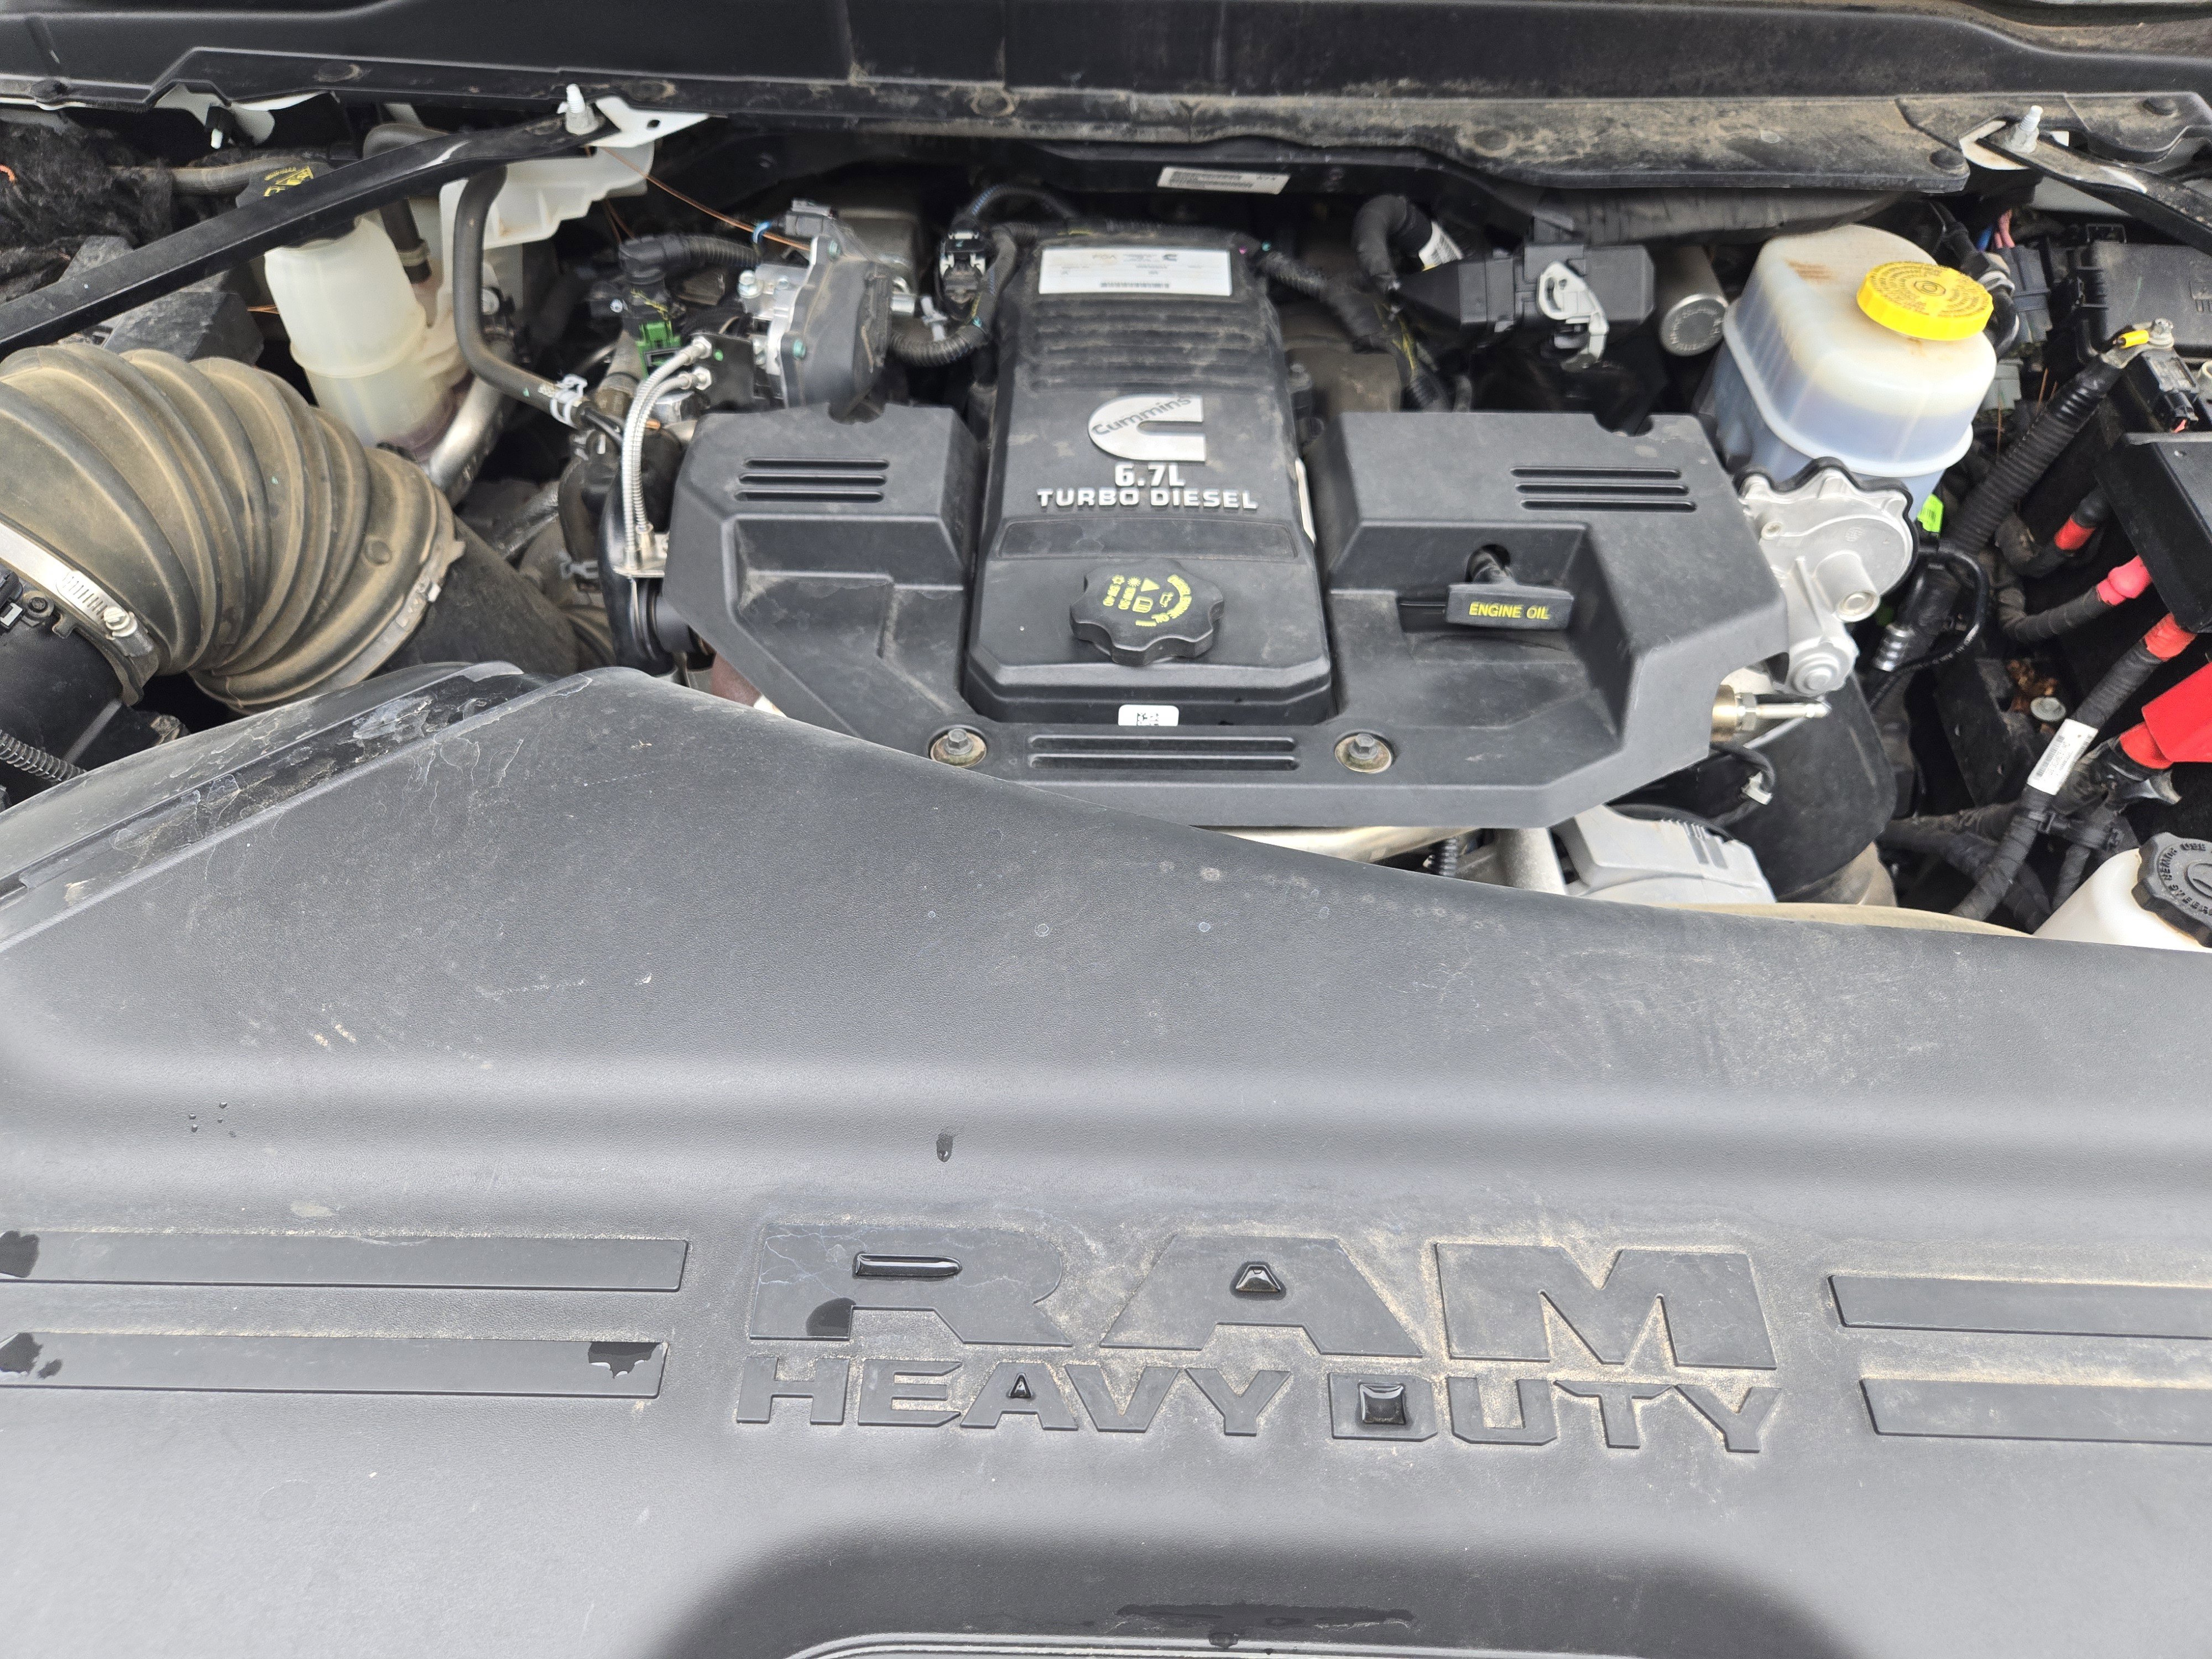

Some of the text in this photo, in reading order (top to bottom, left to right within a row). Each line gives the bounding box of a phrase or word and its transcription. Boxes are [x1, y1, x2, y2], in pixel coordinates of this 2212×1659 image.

[1092, 397, 1192, 435] Cummins
[1114, 462, 1186, 487] 6.7L
[1037, 487, 1259, 509] TURBO DIESEL
[1469, 602, 1551, 620] ENGINE OIL
[749, 1223, 1777, 1370] RAM
[736, 1355, 1782, 1453] HEAVY DUTY
